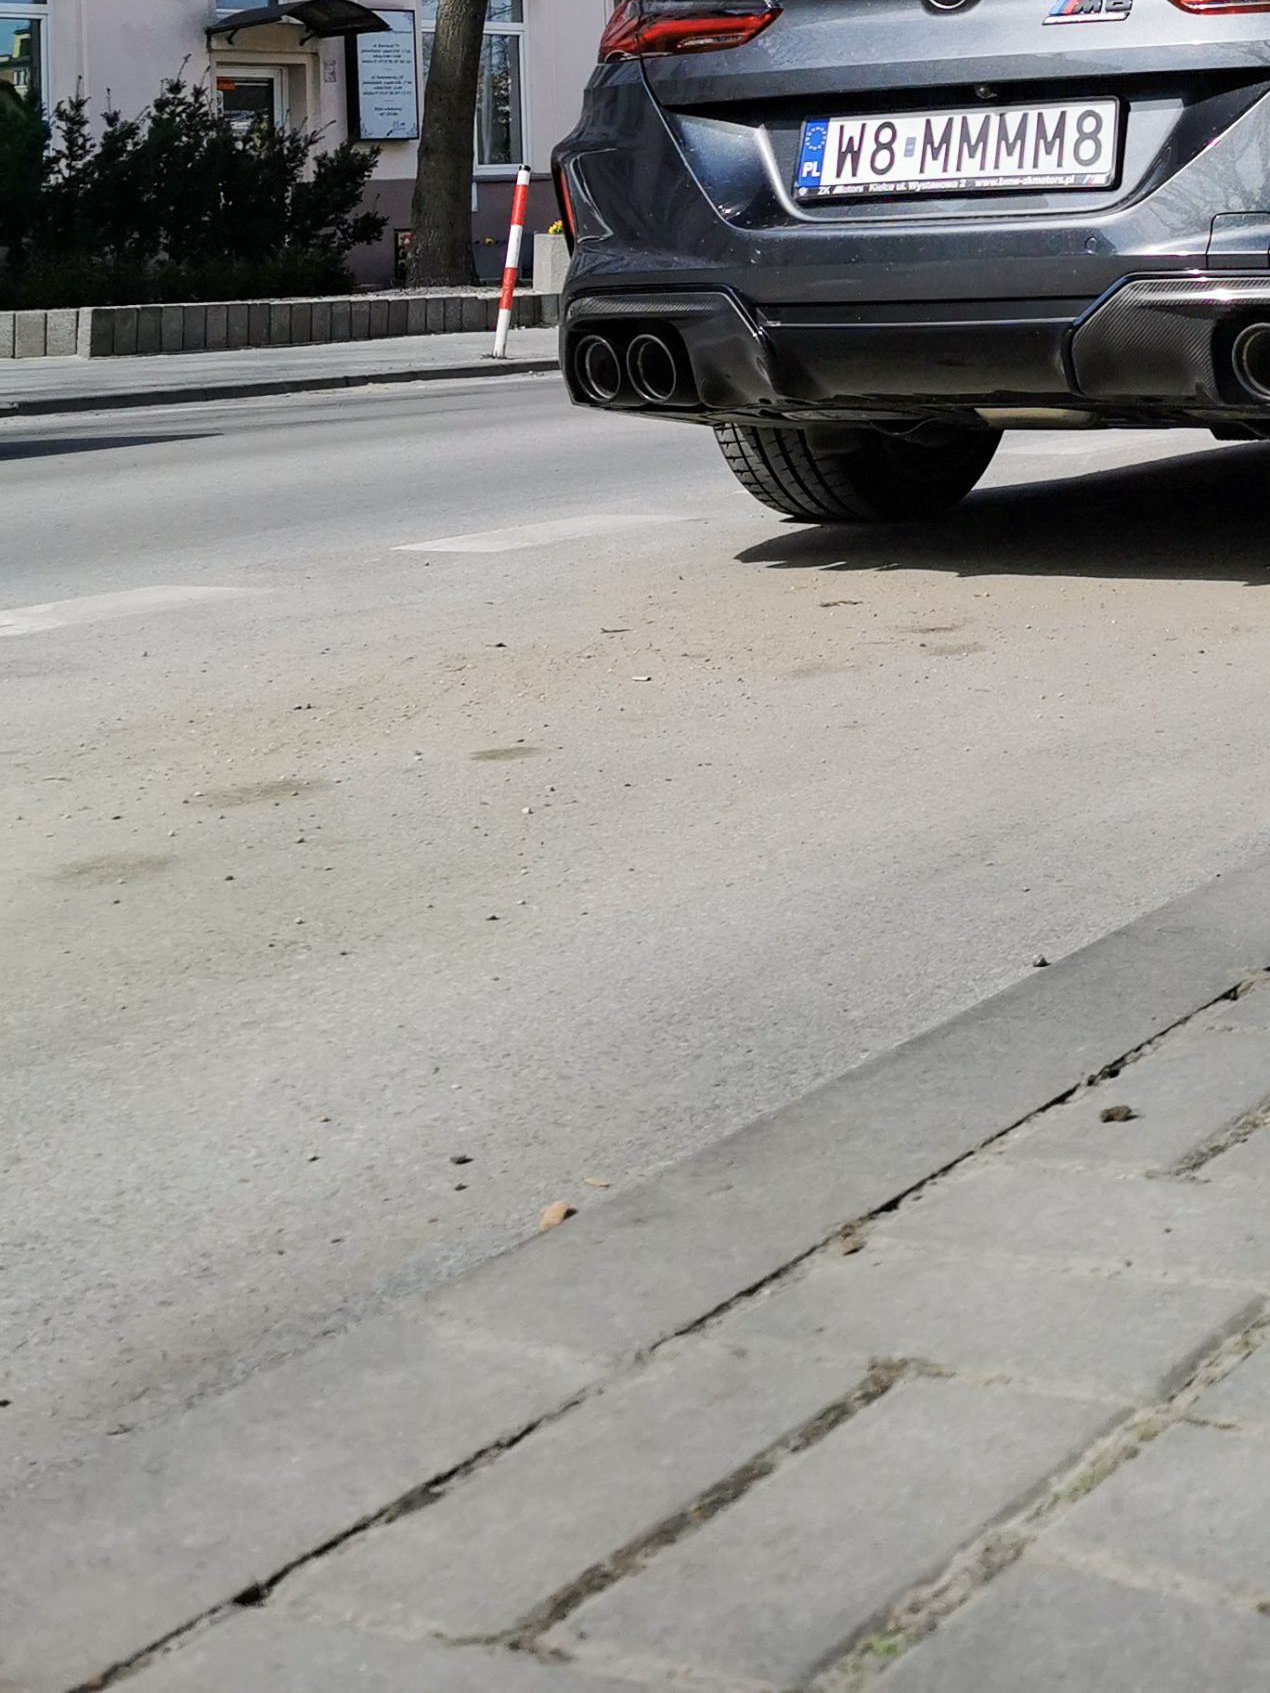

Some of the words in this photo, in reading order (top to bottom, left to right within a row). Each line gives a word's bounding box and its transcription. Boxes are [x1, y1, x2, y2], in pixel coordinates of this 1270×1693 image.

[835, 120, 898, 179] W8
[918, 108, 1104, 175] MMMM8
[801, 160, 821, 179] PL
[959, 179, 967, 188] 2
